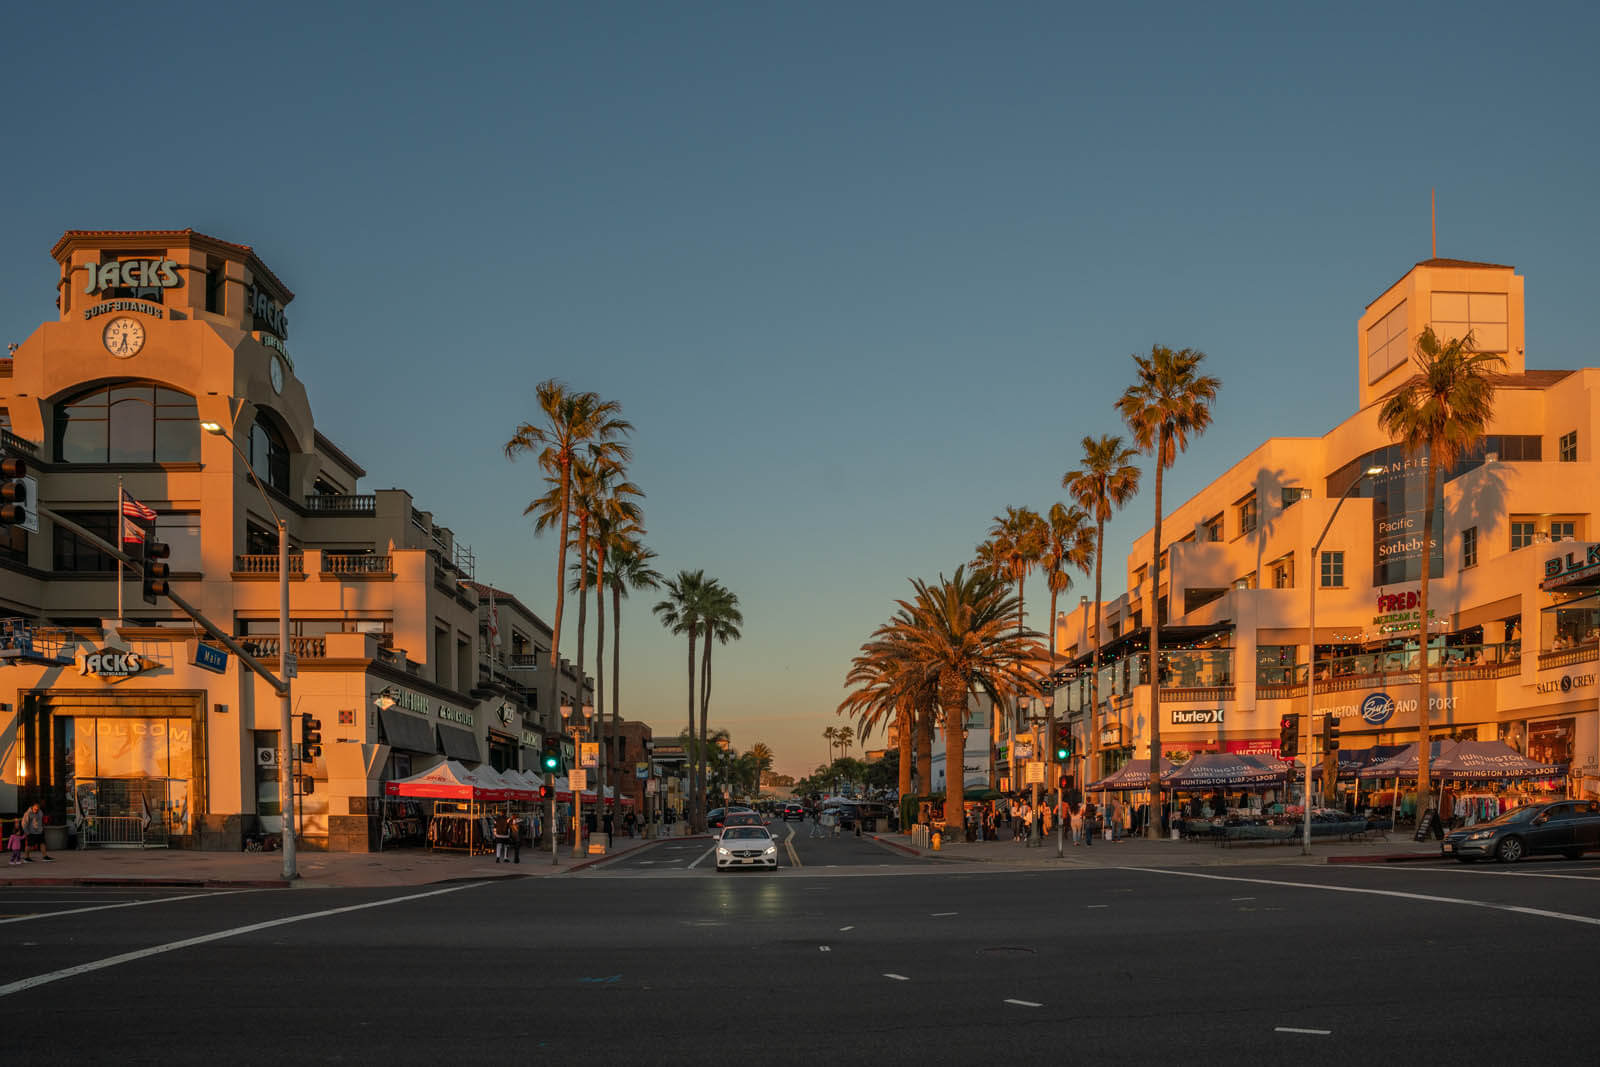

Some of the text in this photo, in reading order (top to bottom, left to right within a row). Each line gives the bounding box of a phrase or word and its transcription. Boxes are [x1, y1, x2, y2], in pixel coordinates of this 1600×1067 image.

[84, 256, 178, 294] JACK'S
[84, 301, 164, 320] SURFBOARDS
[1379, 519, 1414, 534] Pacific
[1379, 538, 1436, 557] Sothebys
[1545, 544, 1600, 576] BLK
[80, 651, 140, 676] JACK'S
[205, 650, 222, 666] Main
[1536, 680, 1560, 695] SALTY
[1572, 674, 1596, 689] CREW
[1395, 699, 1418, 713] AND
[1428, 696, 1459, 711] PORT
[1172, 711, 1211, 722] Hurley
[79, 722, 189, 743] VOLCOM
[1181, 774, 1278, 786] HUNTINGTON SURF SPORT
[1506, 769, 1524, 777] SURF
[1535, 767, 1559, 775] SPORT
